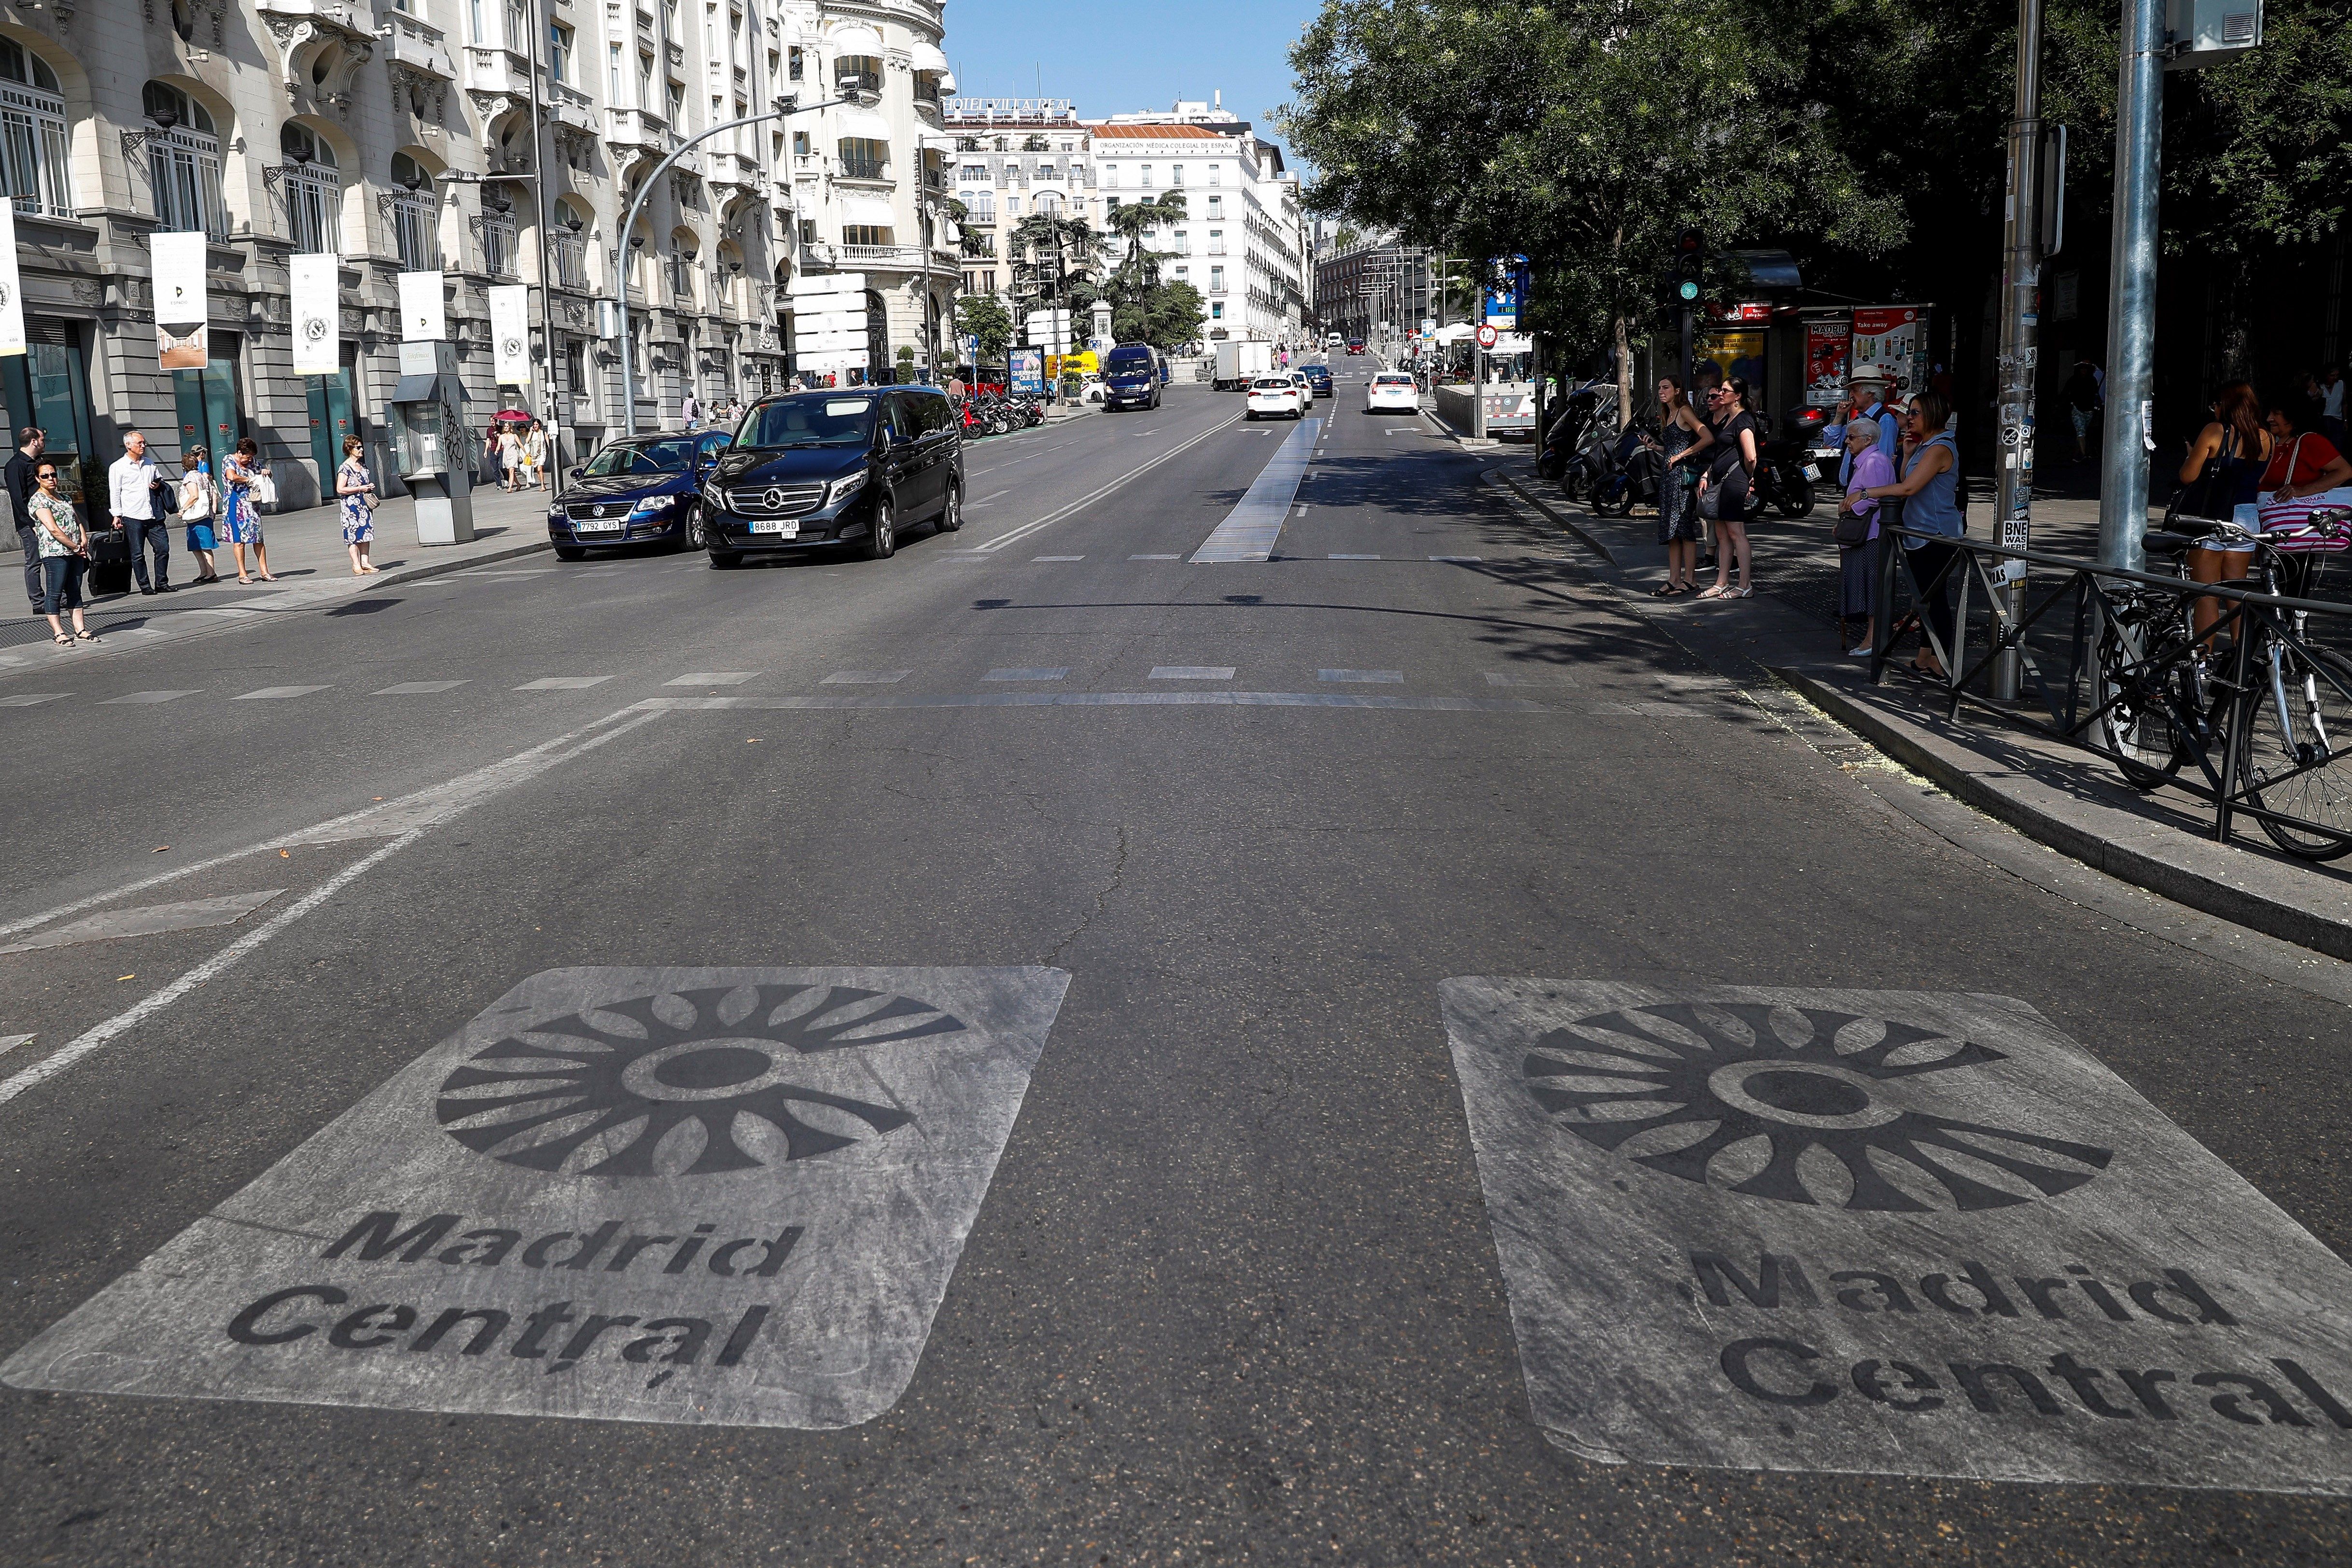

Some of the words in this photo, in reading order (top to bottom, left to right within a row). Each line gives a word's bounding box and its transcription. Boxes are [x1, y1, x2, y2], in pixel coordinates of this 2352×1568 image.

[943, 98, 984, 111] HOTEL
[991, 98, 1031, 112] VILLA
[1037, 98, 1071, 111] REAL
[1811, 324, 1848, 334] MADRID
[603, 521, 617, 530] GYS
[755, 522, 777, 531] 8688
[780, 520, 797, 530] JRD
[2005, 522, 2027, 535] BNE
[319, 1211, 806, 1278] Madrid
[1690, 1252, 2241, 1327] Madrid
[227, 1284, 771, 1367] Central
[1720, 1337, 2352, 1429] Central
